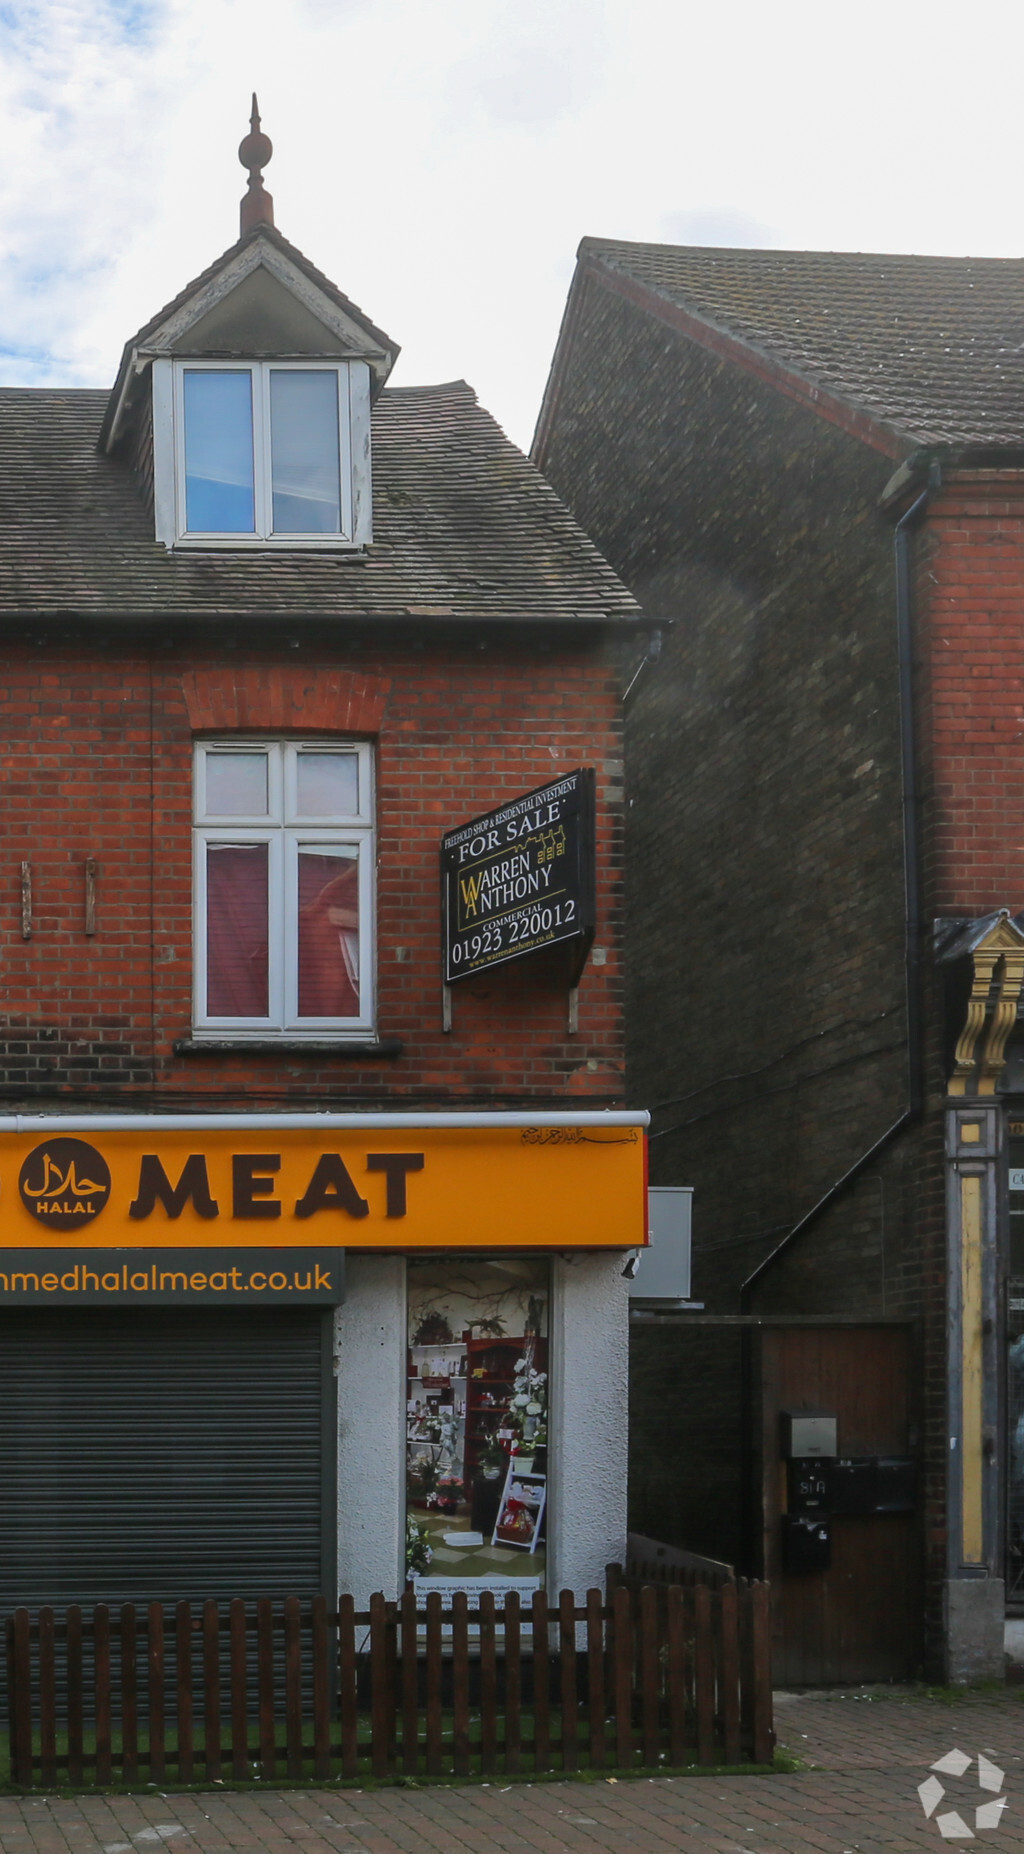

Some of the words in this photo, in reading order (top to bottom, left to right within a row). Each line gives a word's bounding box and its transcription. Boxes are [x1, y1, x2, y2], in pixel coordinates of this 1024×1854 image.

[444, 826, 473, 850] FREEHOLD
[473, 819, 490, 836] SHOP
[489, 819, 495, 828] &
[495, 799, 535, 826] RESIDENTIAL
[535, 780, 577, 809] INVESTMENT
[458, 830, 502, 863] FOR
[506, 801, 561, 841] SALE
[461, 851, 530, 905] WARREN
[465, 864, 552, 919] ANTHONY
[452, 928, 502, 963] 01923
[509, 900, 576, 944] 220012
[482, 903, 543, 932] COMMERCIAL
[469, 930, 556, 968] www.warrenanthony.co.uk
[23, 1153, 106, 1197] حلال
[129, 1152, 425, 1219] MEAT
[37, 1201, 96, 1214] HALAL
